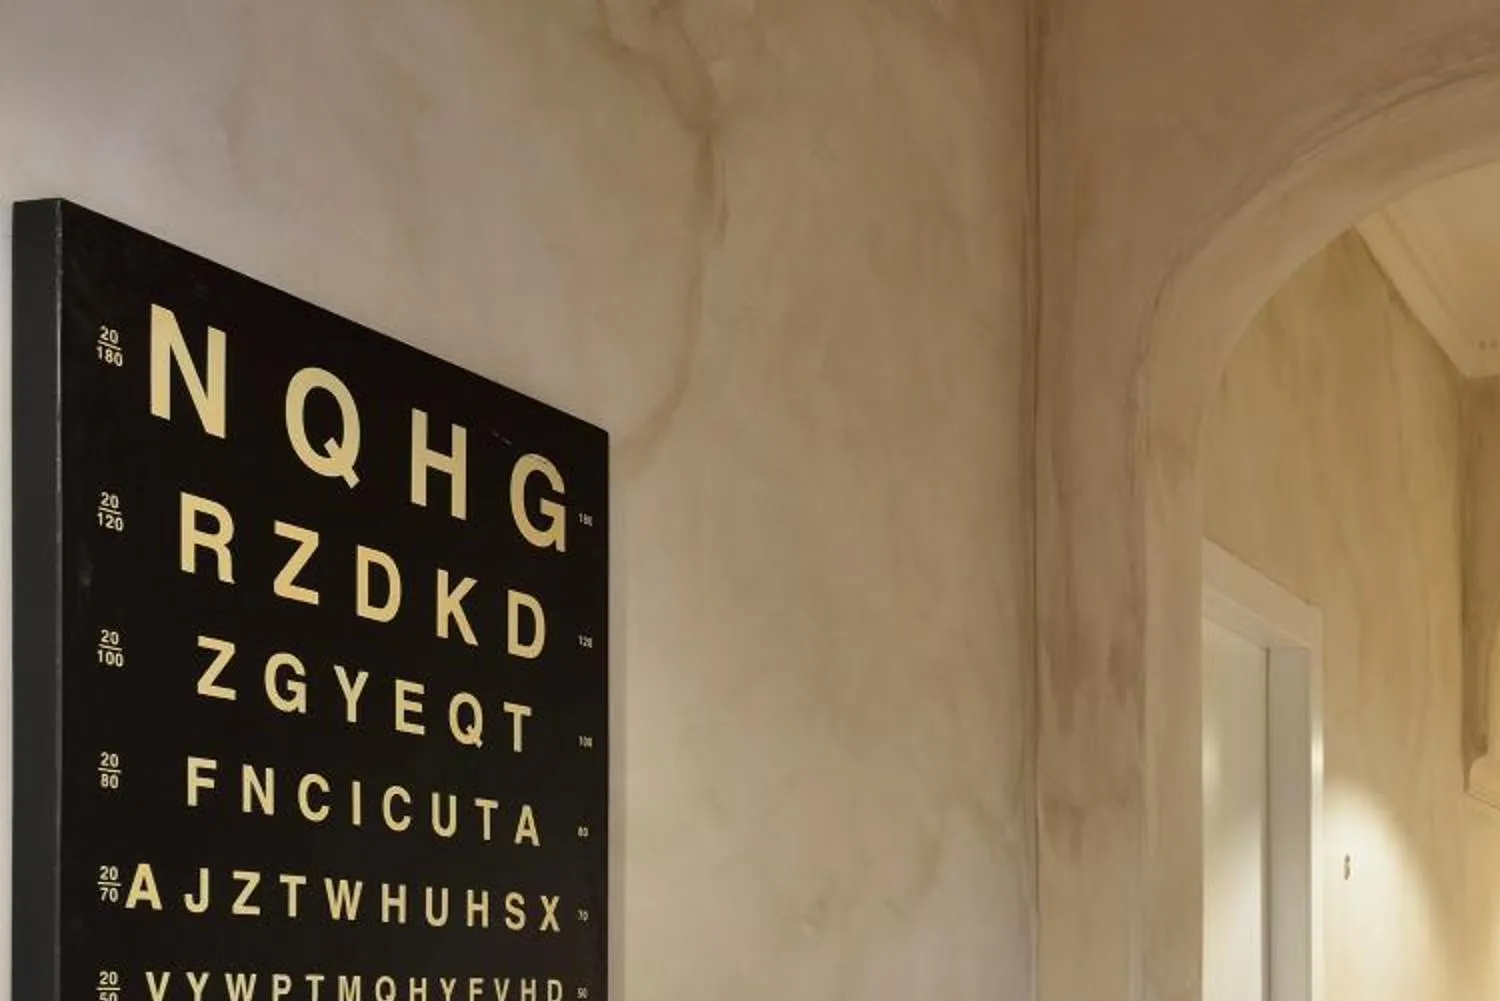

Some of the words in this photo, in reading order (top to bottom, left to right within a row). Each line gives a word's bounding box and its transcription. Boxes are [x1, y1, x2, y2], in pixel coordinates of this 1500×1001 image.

[100, 326, 119, 344] 20
[97, 345, 124, 367] 180
[101, 492, 120, 510] 20
[97, 512, 125, 532] 120
[101, 629, 120, 646] 20
[97, 649, 125, 668] 100
[101, 752, 120, 769] 20
[100, 772, 119, 790] 80
[100, 865, 119, 881] 20
[100, 886, 119, 902] 70
[100, 970, 119, 986] 20
